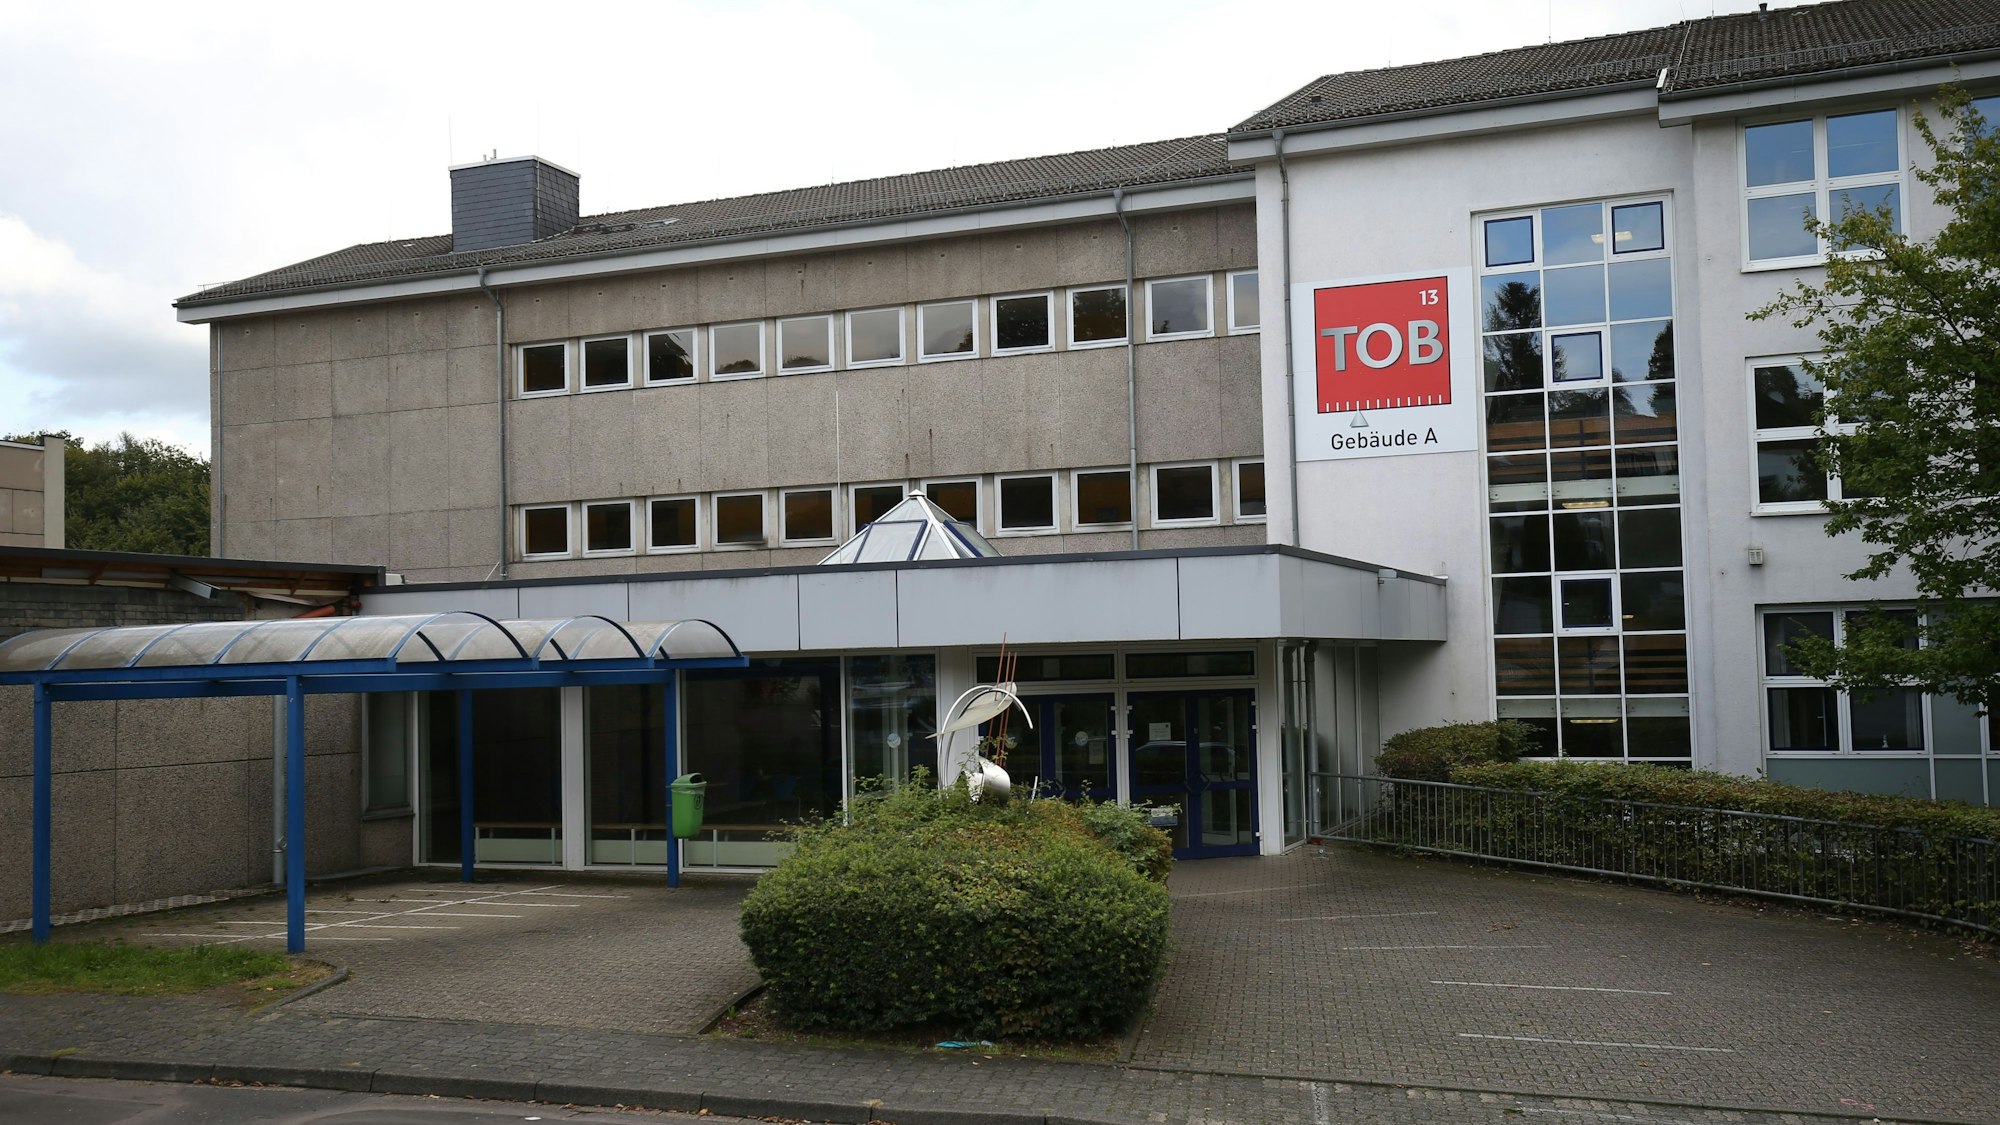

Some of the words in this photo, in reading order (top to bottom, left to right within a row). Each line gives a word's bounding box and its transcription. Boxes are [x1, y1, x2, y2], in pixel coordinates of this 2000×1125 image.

[1419, 289, 1439, 305] 13
[1320, 319, 1444, 371] TOB
[1331, 430, 1418, 450] Gebäude
[1424, 427, 1438, 444] A
